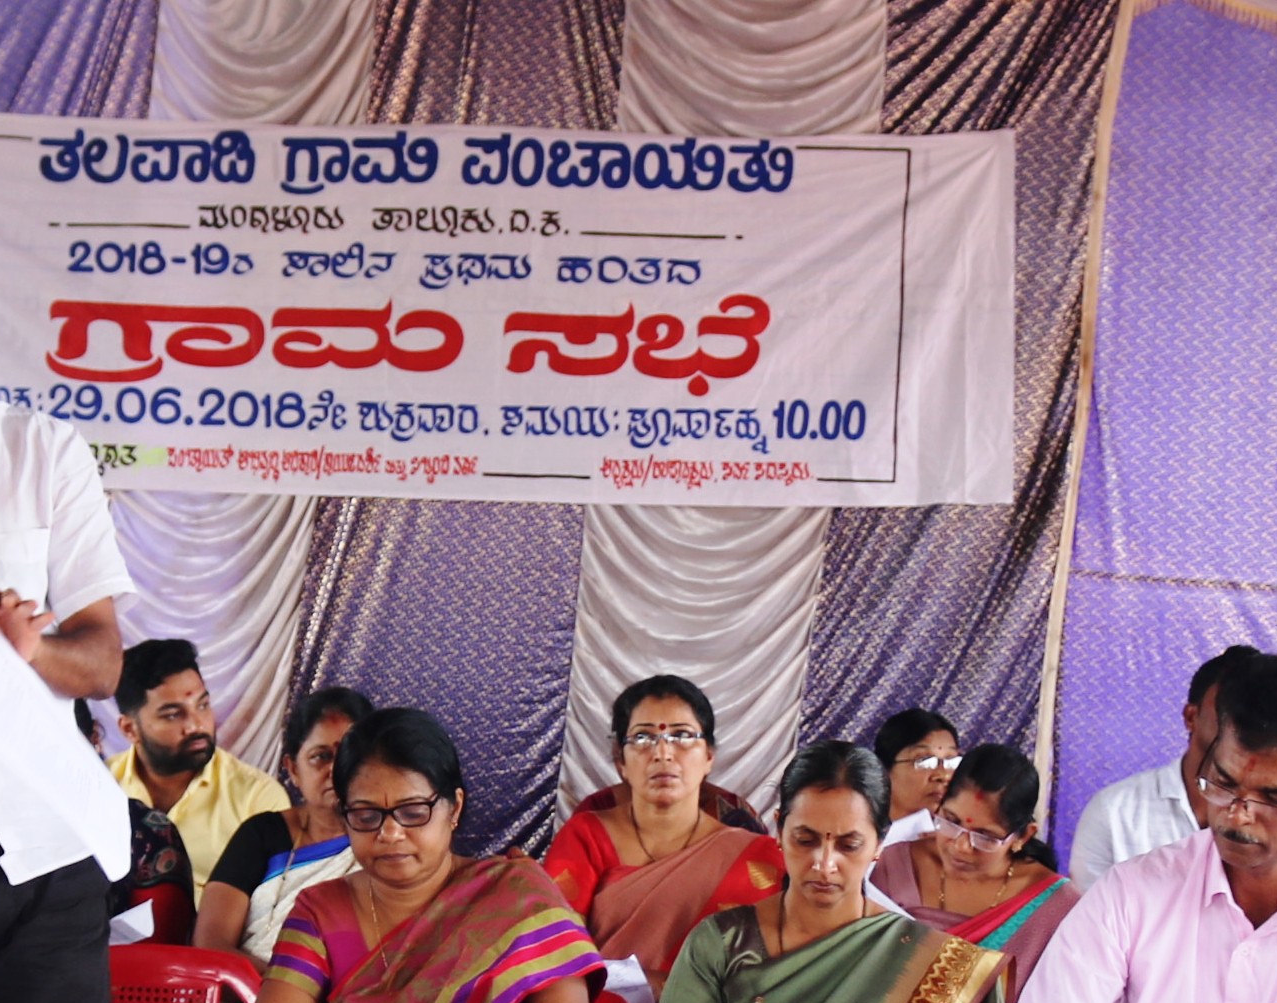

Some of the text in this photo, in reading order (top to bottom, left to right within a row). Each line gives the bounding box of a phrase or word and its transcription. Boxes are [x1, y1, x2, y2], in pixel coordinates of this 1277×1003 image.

[39, 128, 794, 195] ತಲಪಾಡಿ ಗ್ರಾಮ ಪಂಚಾಯತು
[198, 205, 344, 234] ಮಂಗಳೂರು
[67, 240, 701, 290] 2018-19ರ ಸಾಲಿನ ಪ್ರಥಮ ಹಂತದ
[45, 293, 771, 397] ಗ್ರಾಮ ಸಭೆ
[772, 399, 867, 441] 10.00
